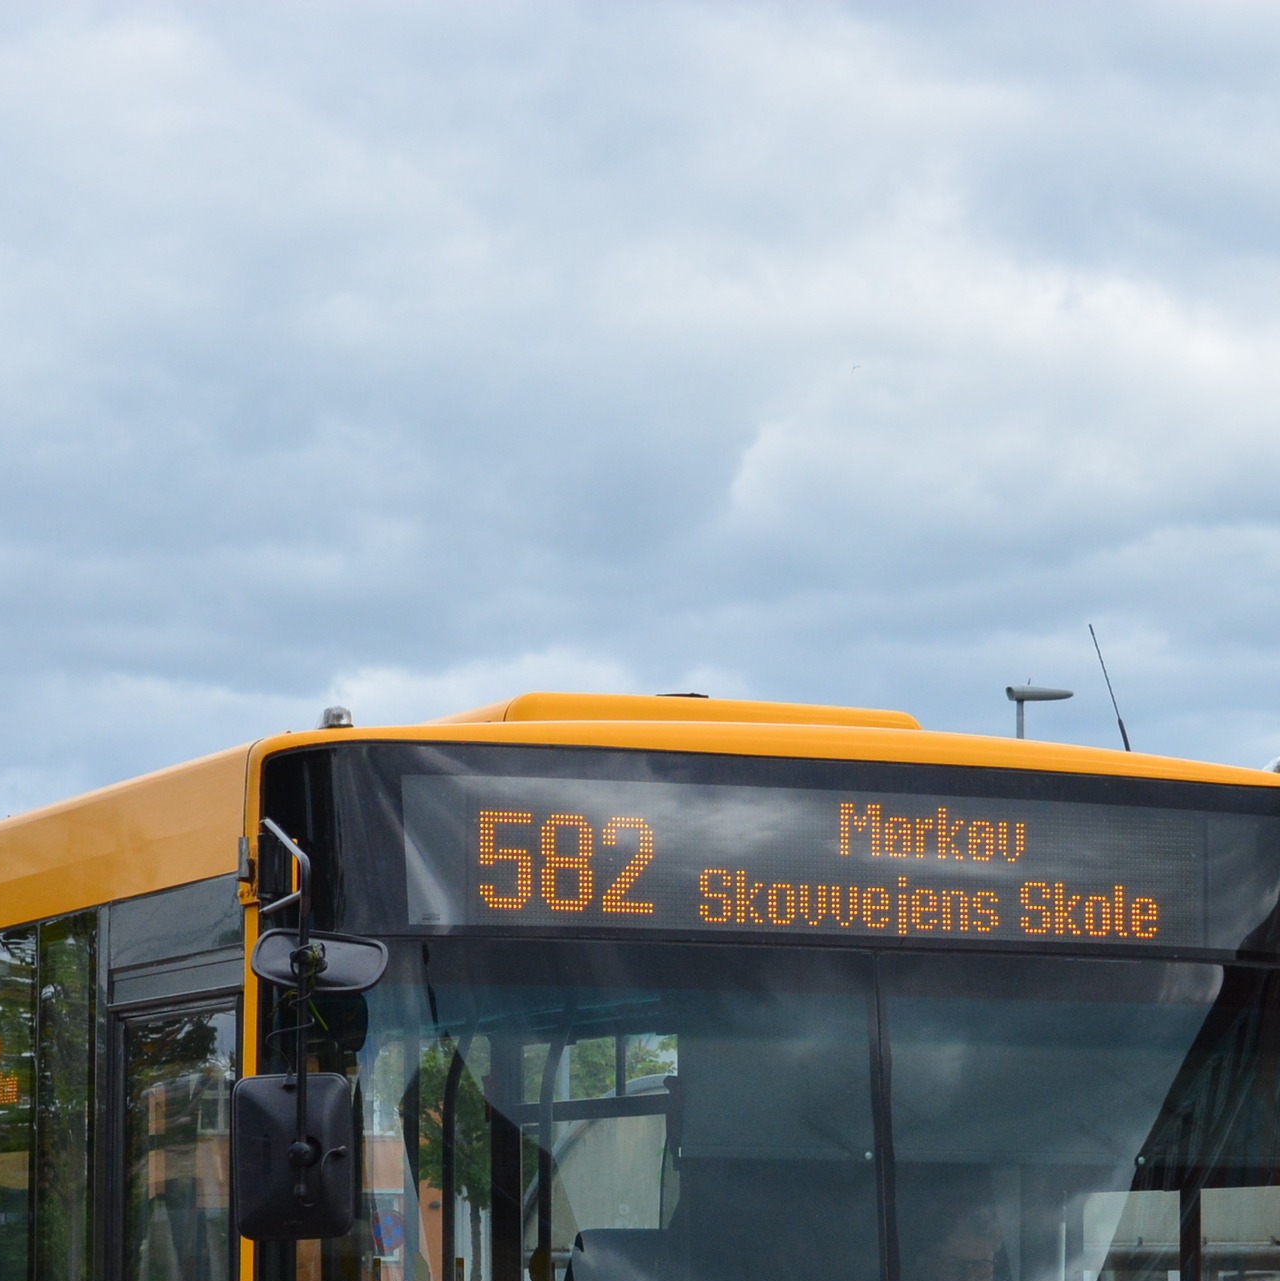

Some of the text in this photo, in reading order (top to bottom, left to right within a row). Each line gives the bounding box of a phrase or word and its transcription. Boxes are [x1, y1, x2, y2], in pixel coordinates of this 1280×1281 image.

[479, 810, 654, 914] 582
[840, 802, 1026, 863] Mørkøv
[698, 868, 1159, 938] Skovvejens Skole
